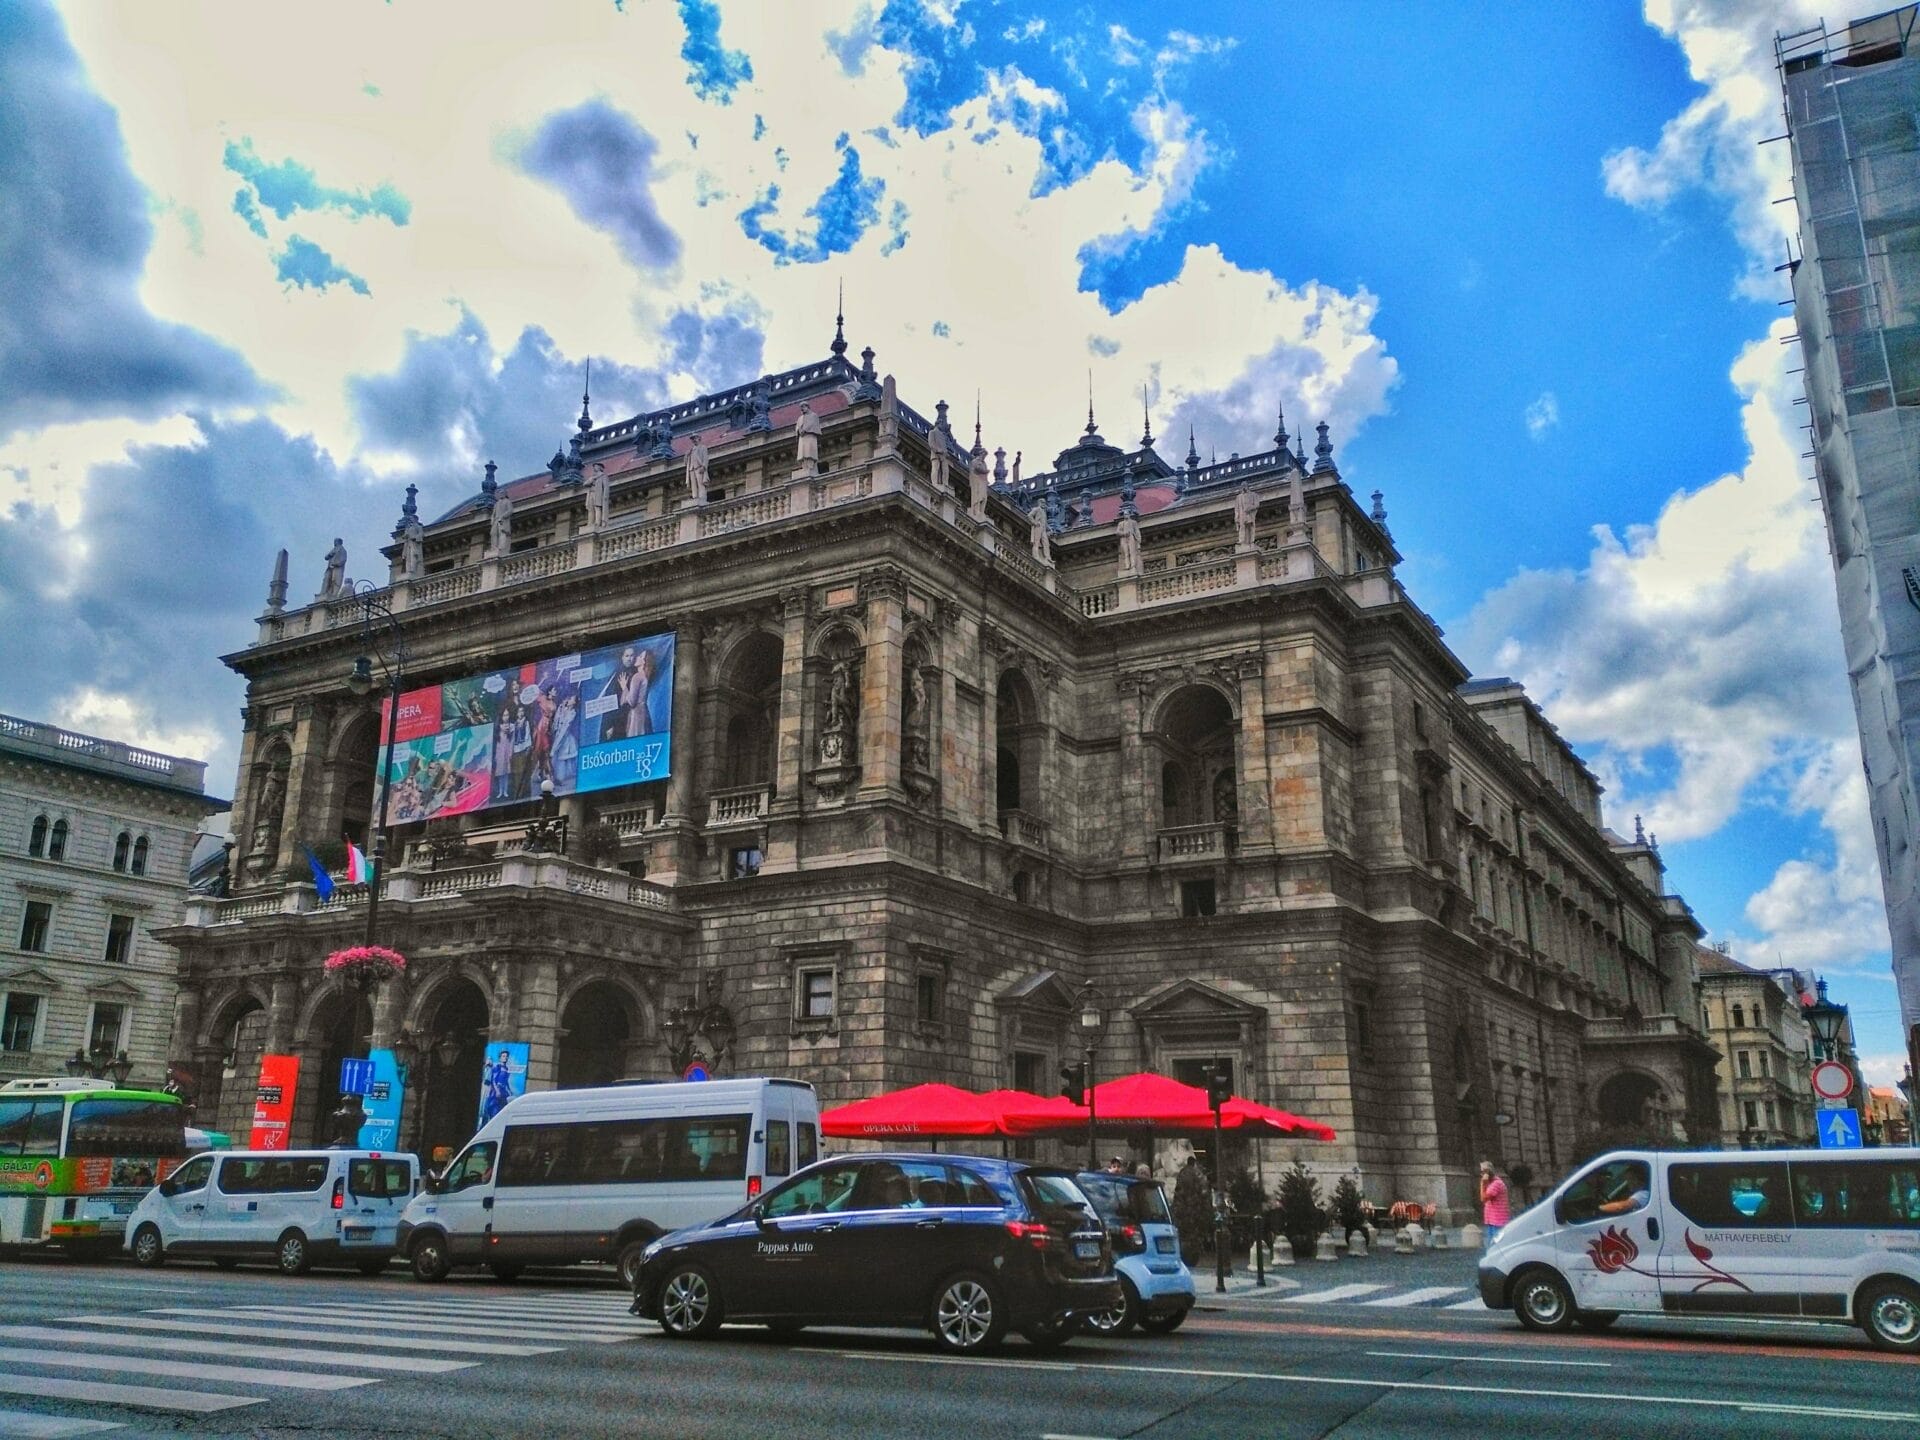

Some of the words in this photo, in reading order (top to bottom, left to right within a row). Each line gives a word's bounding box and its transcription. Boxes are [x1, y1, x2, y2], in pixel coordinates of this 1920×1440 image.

[863, 1124, 894, 1132] OPERA
[757, 1241, 790, 1255] Pappas
[791, 1241, 814, 1252] Auto
